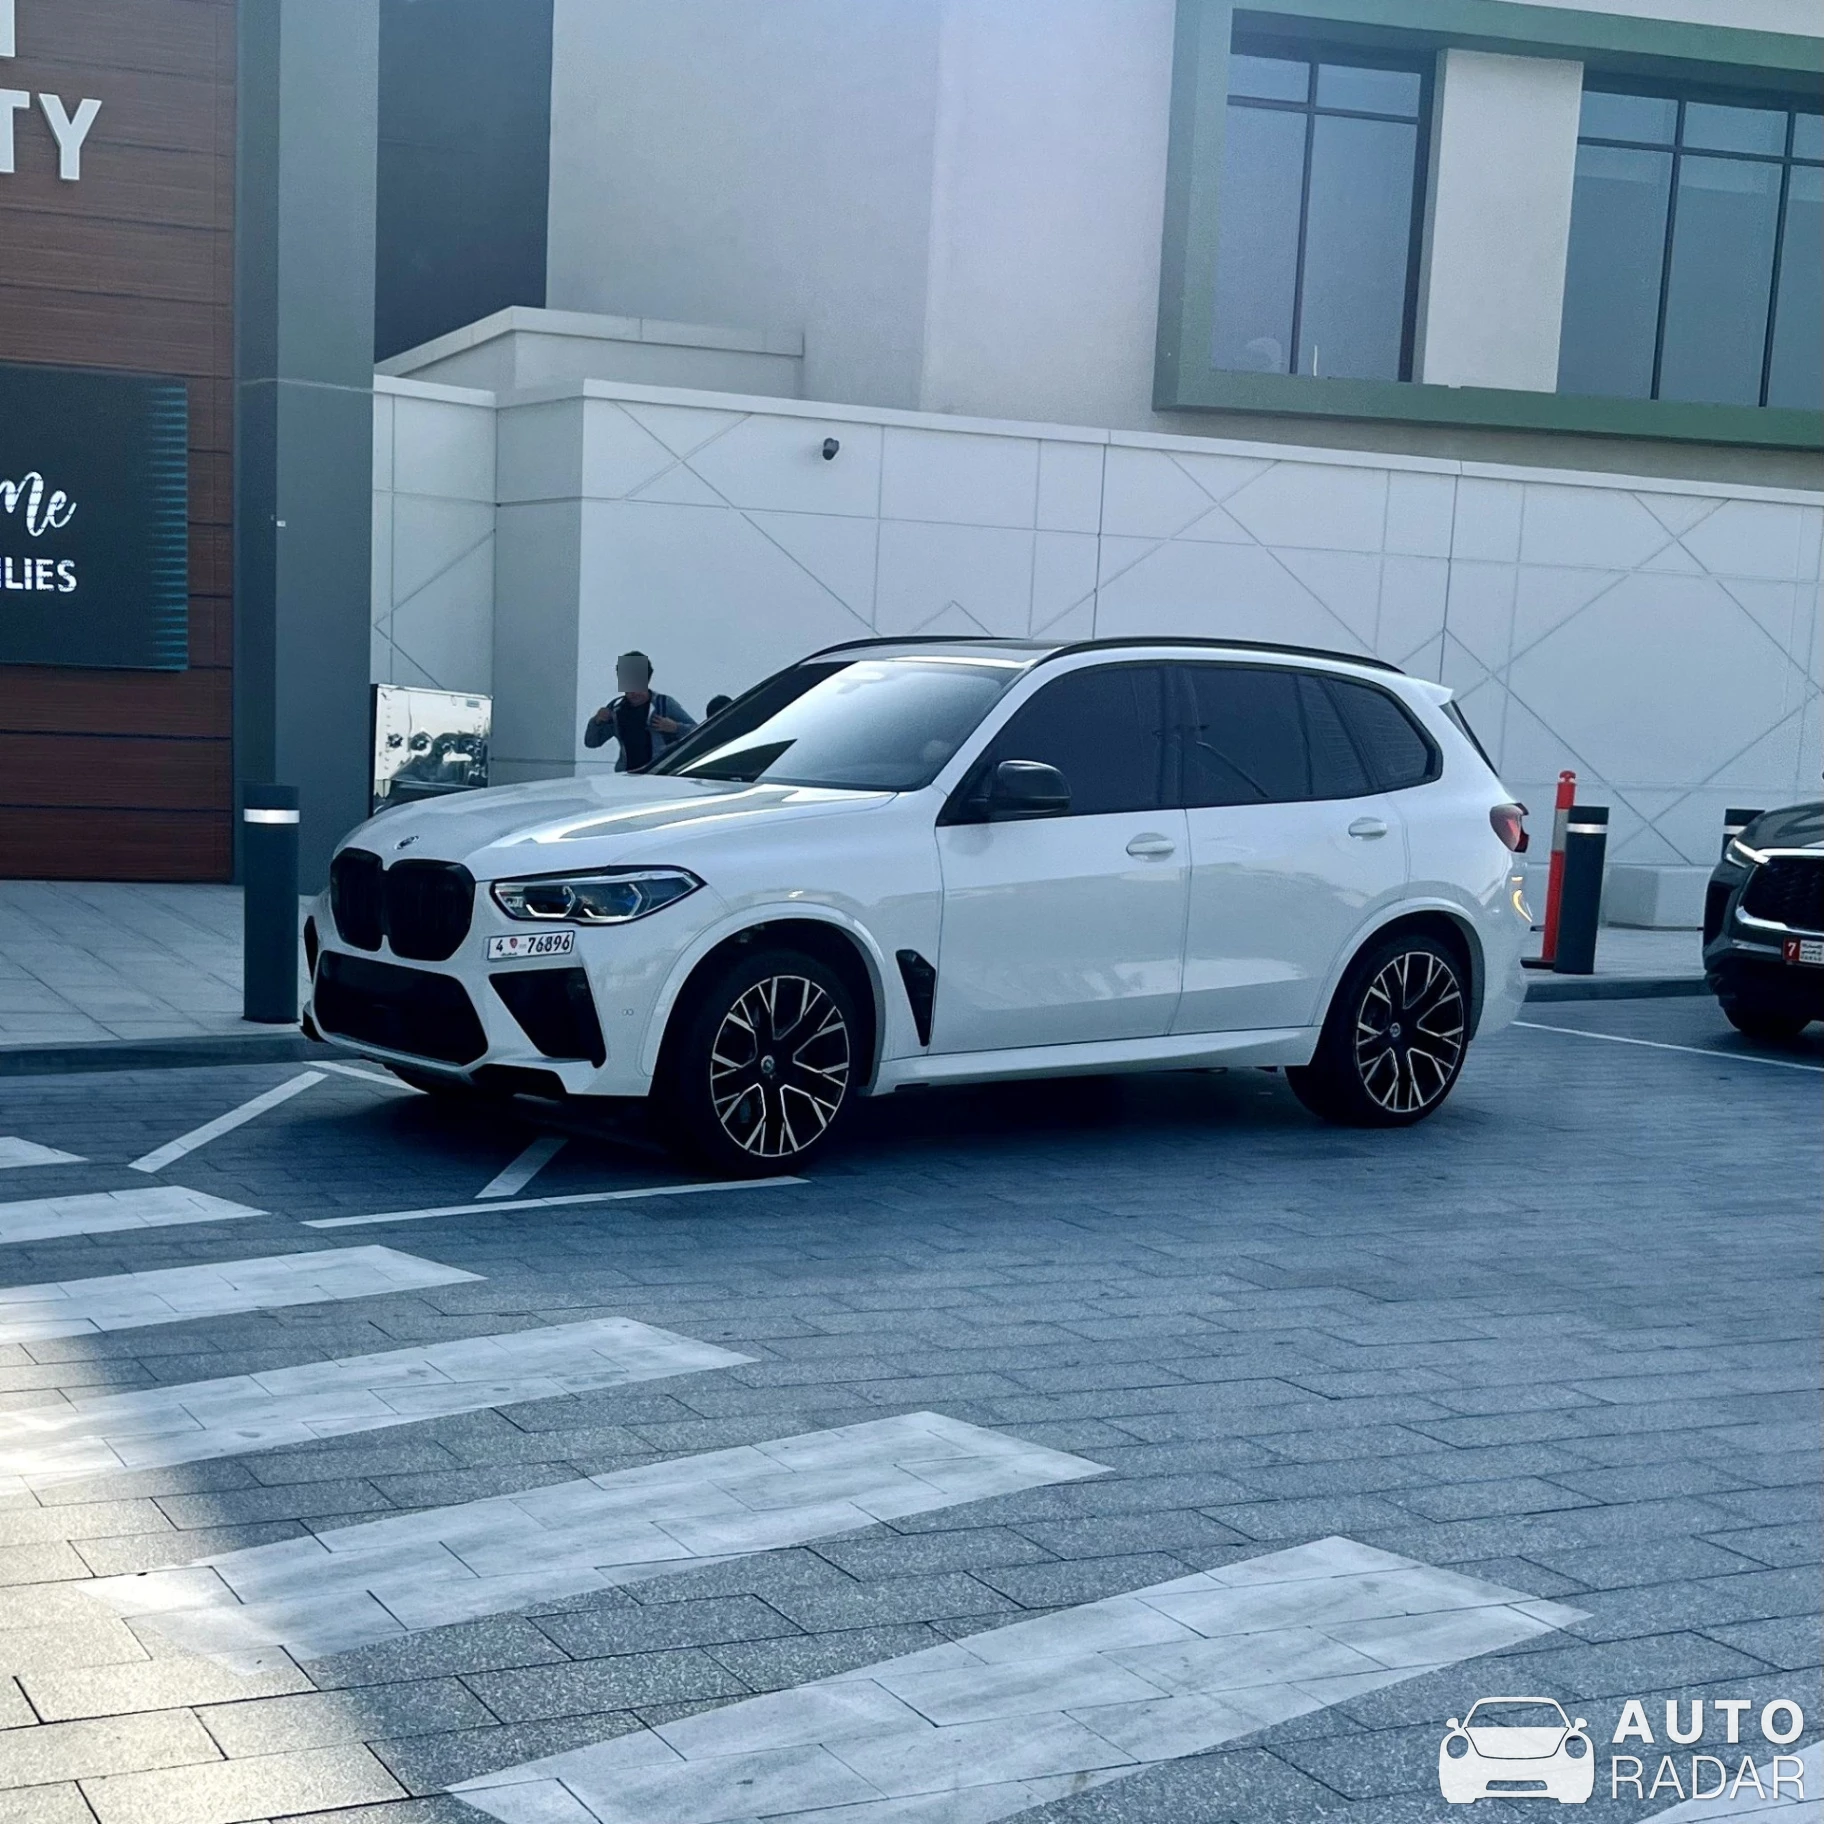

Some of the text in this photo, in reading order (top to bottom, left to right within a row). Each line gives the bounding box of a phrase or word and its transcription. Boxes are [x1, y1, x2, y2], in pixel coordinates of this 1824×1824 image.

[0, 556, 78, 593] LIES
[496, 934, 570, 954] 4 76896
[1787, 941, 1797, 957] 7
